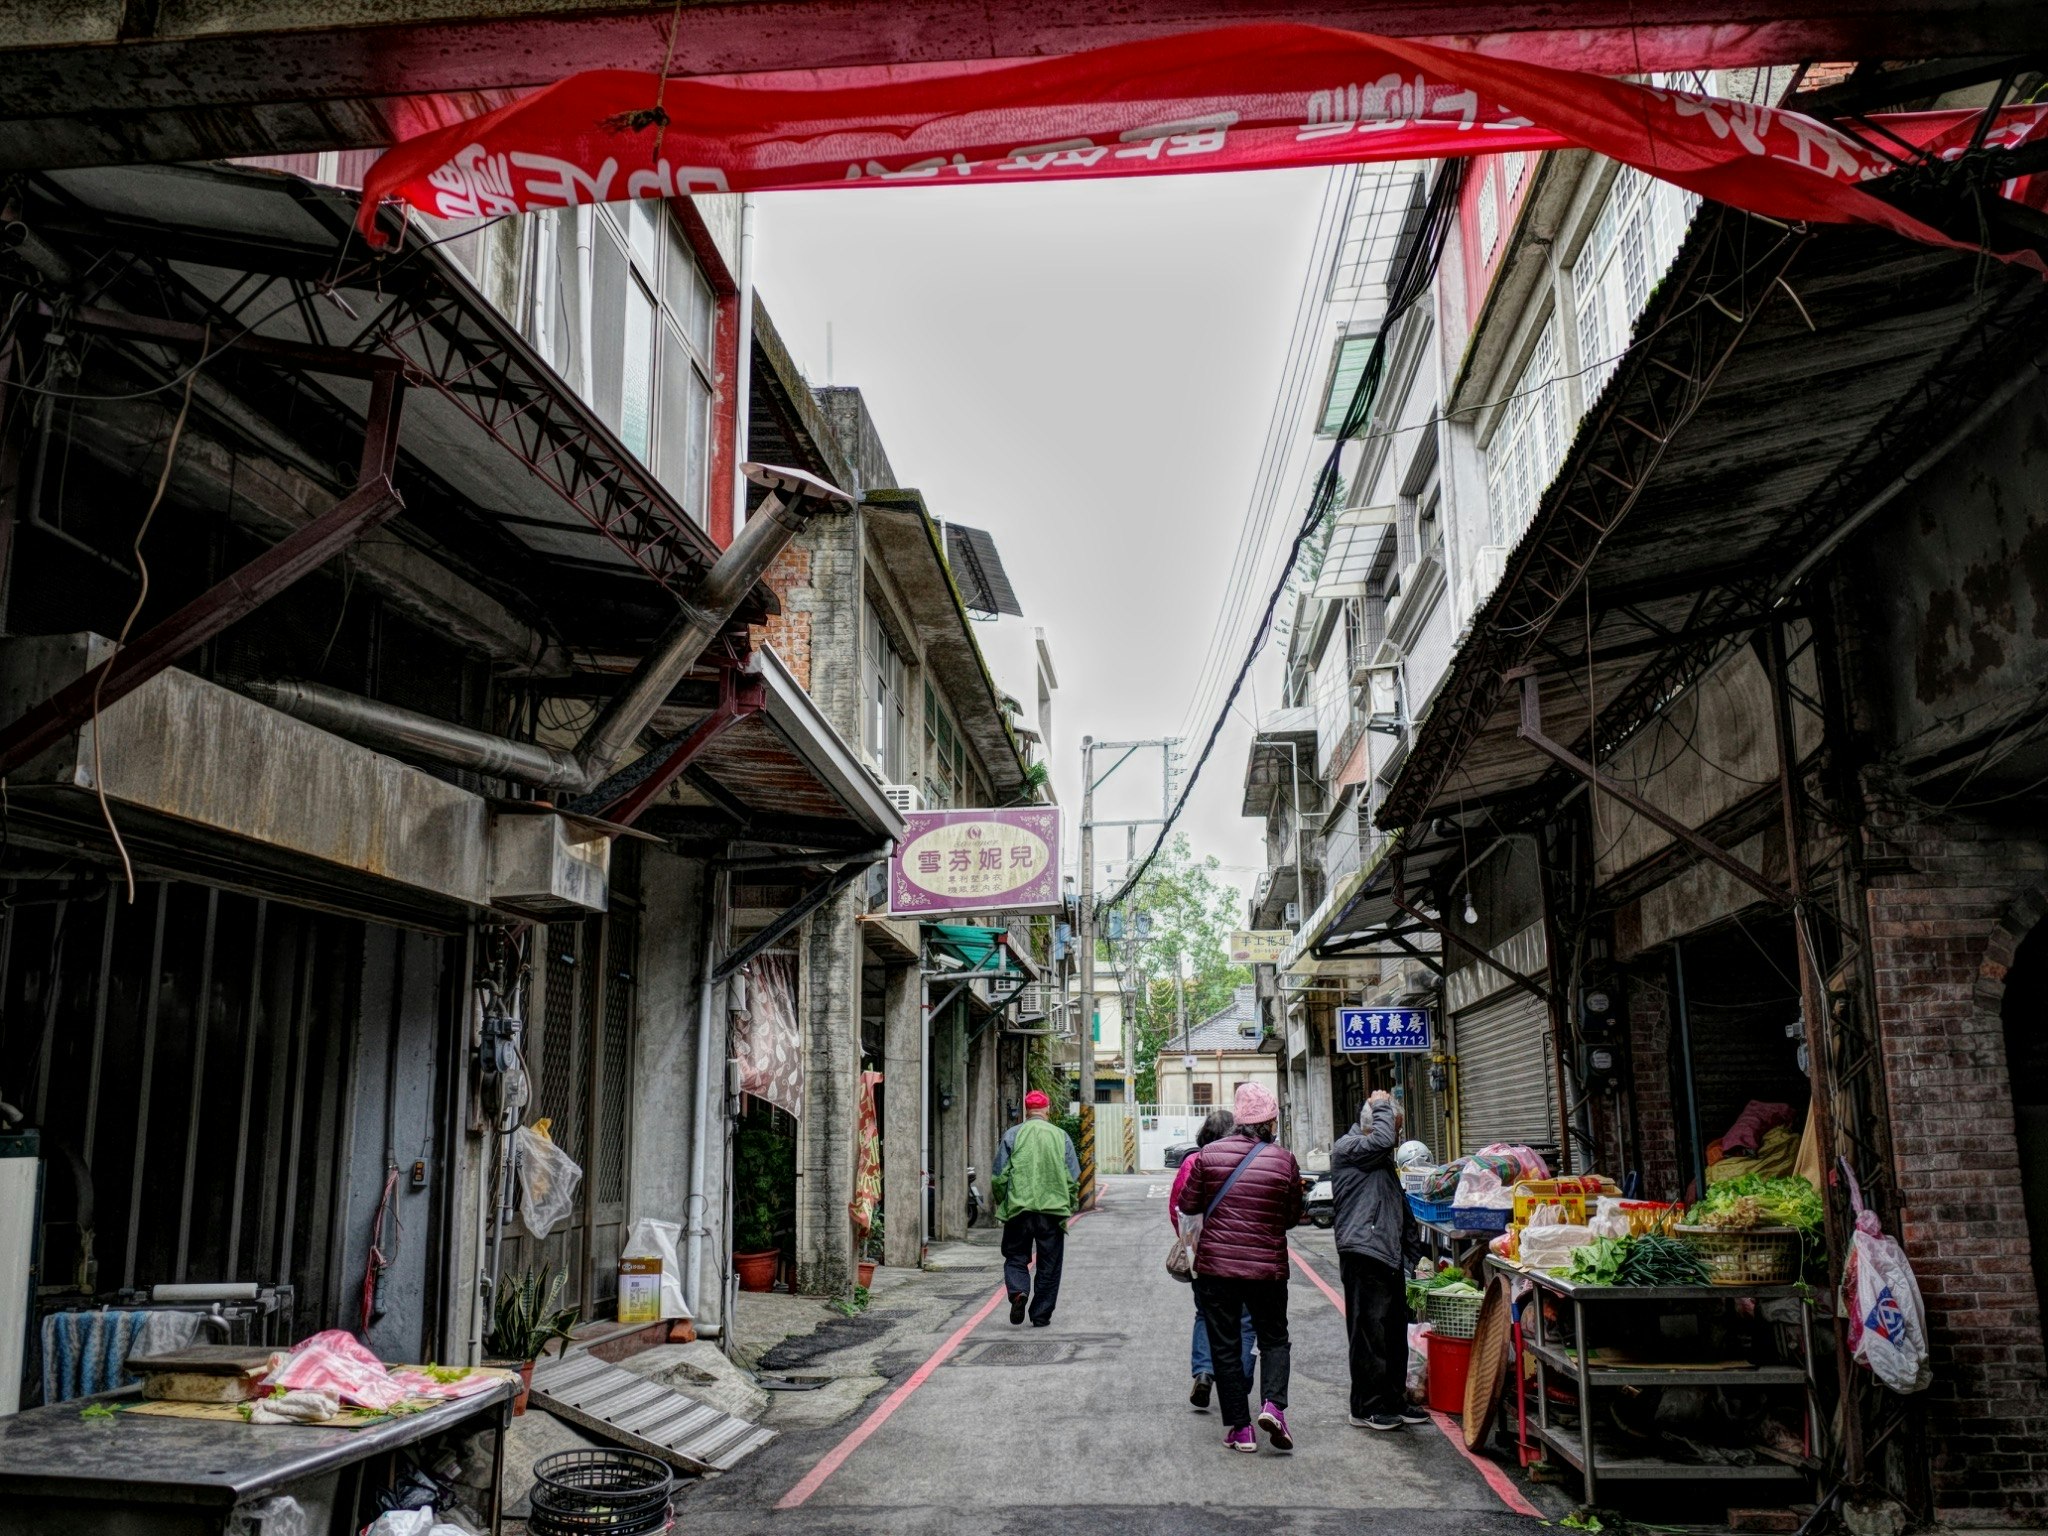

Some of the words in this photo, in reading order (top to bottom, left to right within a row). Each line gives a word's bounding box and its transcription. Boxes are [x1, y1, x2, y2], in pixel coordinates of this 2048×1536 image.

[919, 846, 1033, 873] 雪芬妮兒
[1241, 935, 1288, 947] 手工花生
[1346, 1013, 1425, 1035] 廣育藥房
[1347, 1035, 1425, 1046] 03-5872712
